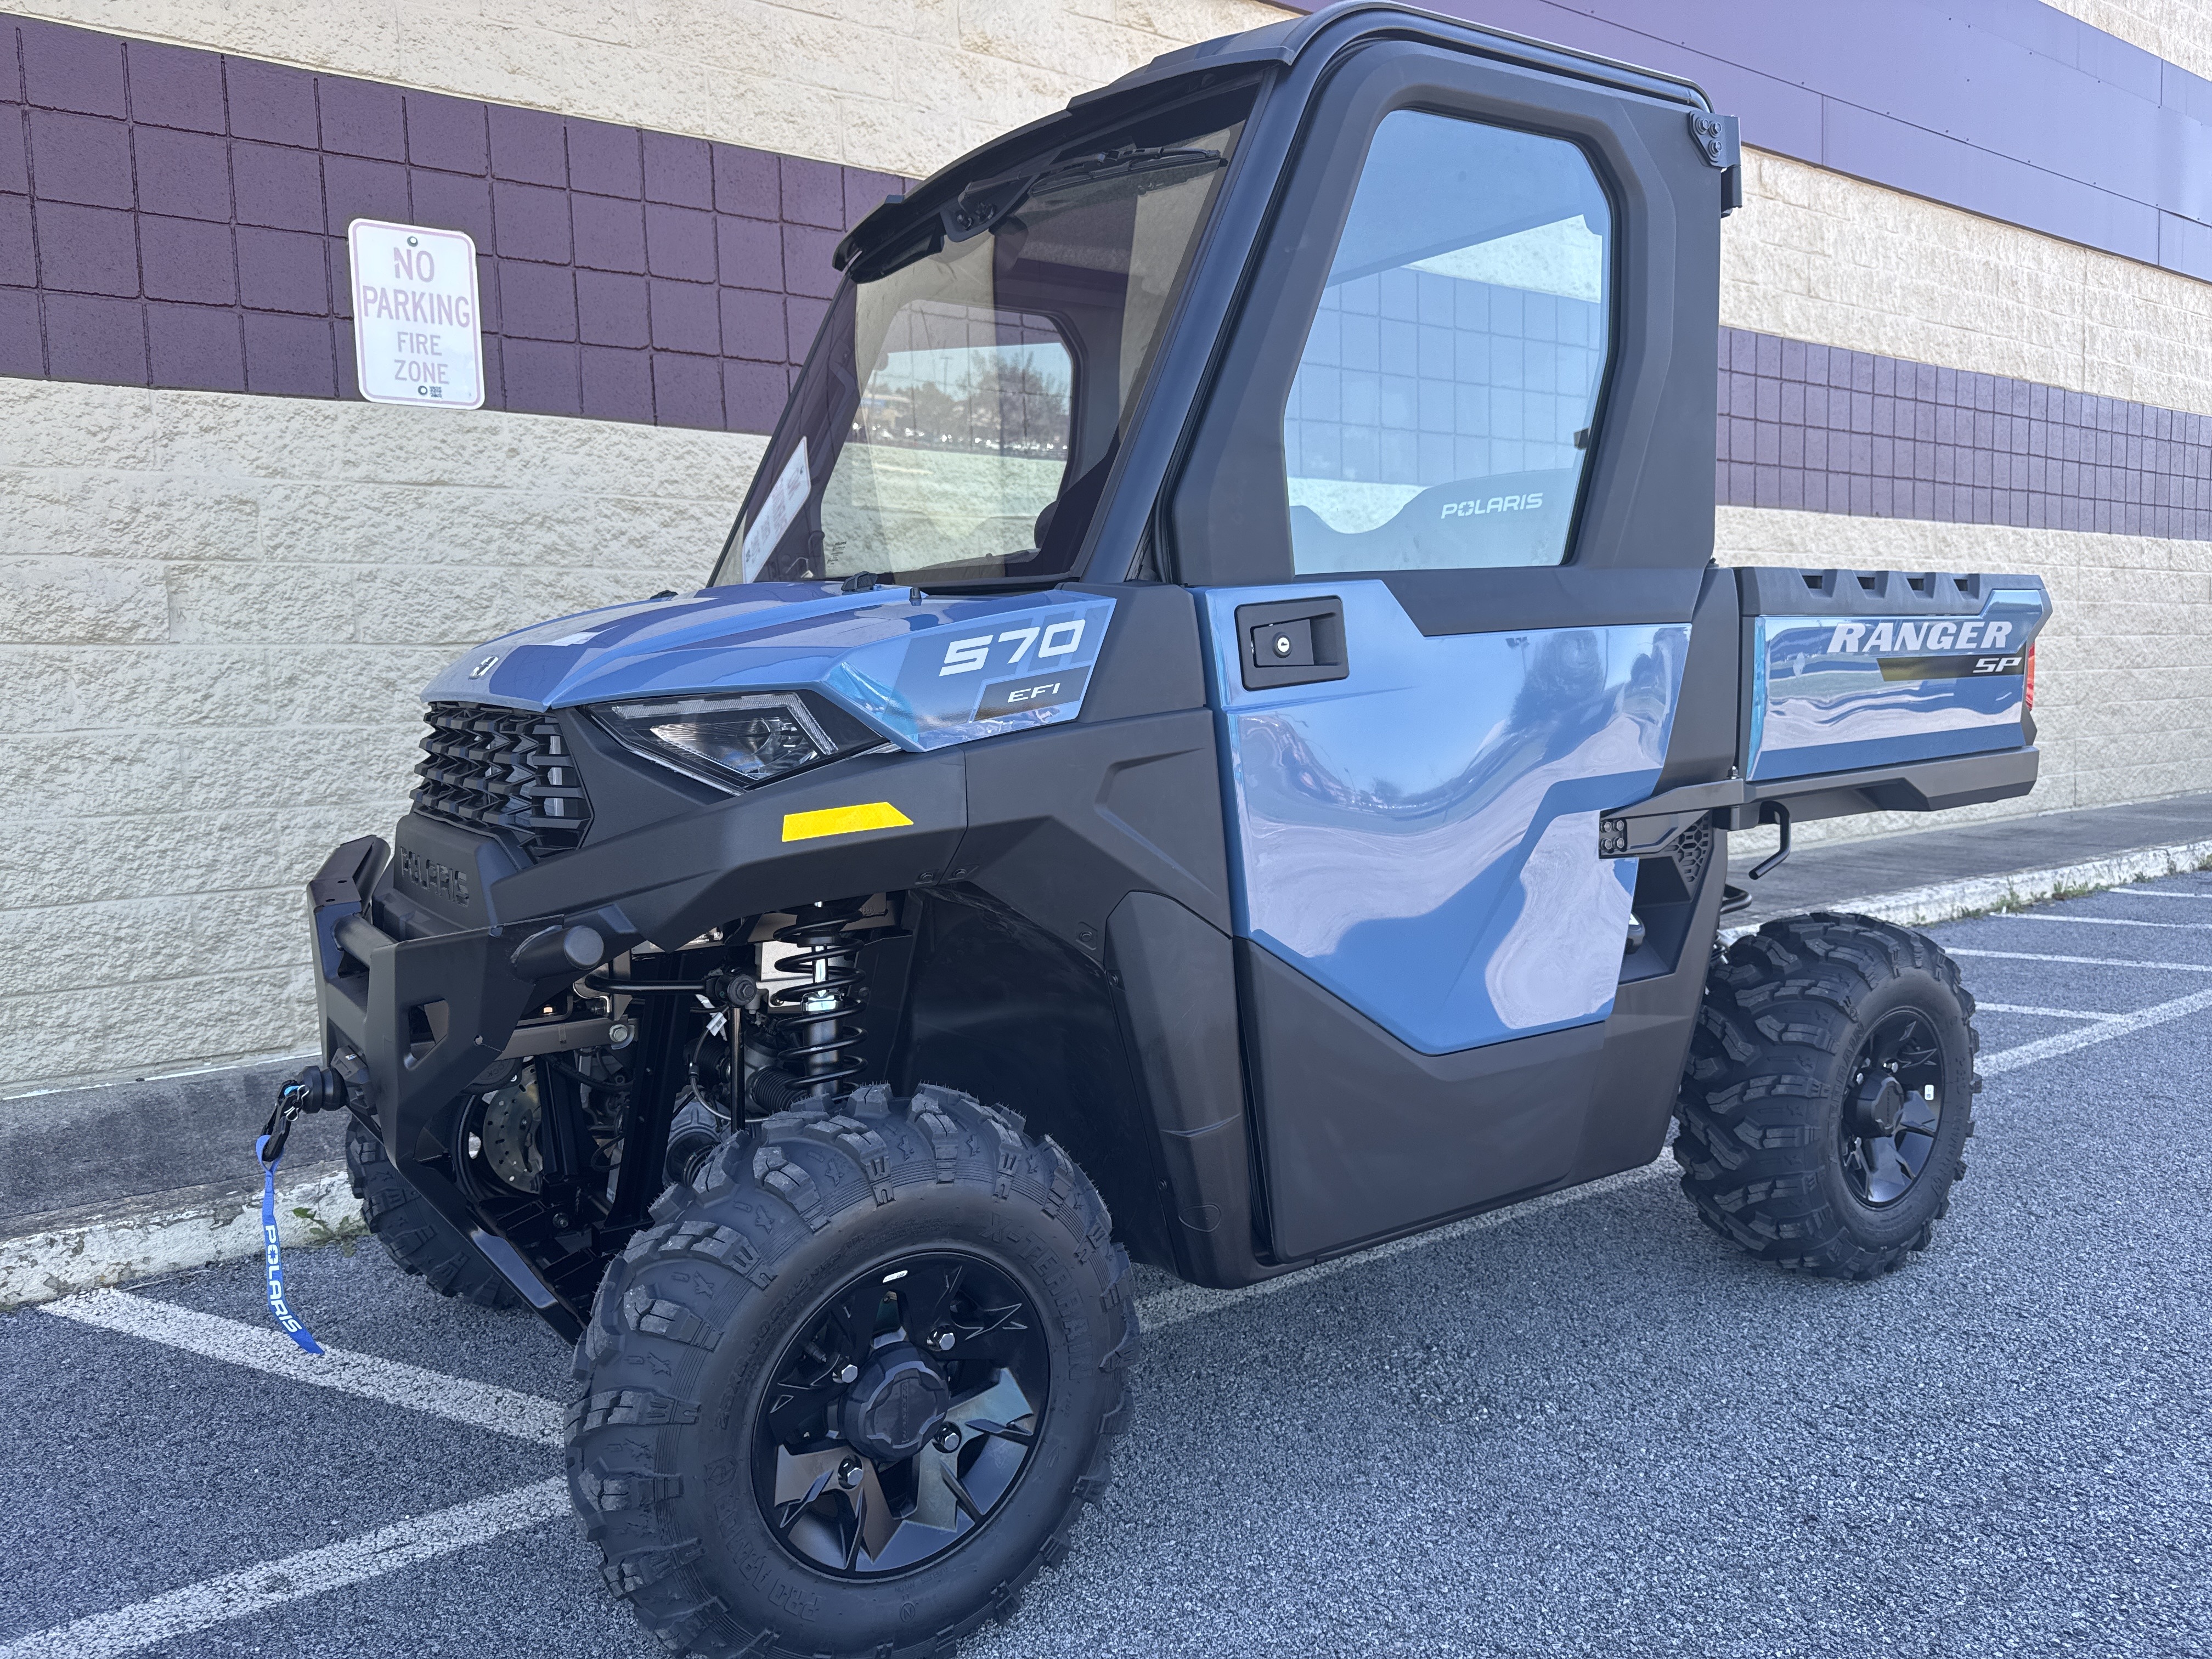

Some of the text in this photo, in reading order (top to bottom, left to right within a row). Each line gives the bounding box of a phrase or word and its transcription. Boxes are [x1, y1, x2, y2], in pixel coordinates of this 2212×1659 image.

[393, 247, 435, 283] NO
[362, 285, 470, 328] PARKING
[397, 331, 443, 356] FIRE
[394, 359, 449, 385] ZONE
[1441, 493, 1543, 519] POLARIS
[939, 619, 1086, 676] 570
[1826, 621, 2013, 653] RANGER
[1972, 657, 2022, 674] SP
[1007, 683, 1060, 703] EFI
[400, 845, 469, 907] POLARIS
[265, 1224, 302, 1333] POLARIS
[979, 1211, 1093, 1380] X-TERRAIN
